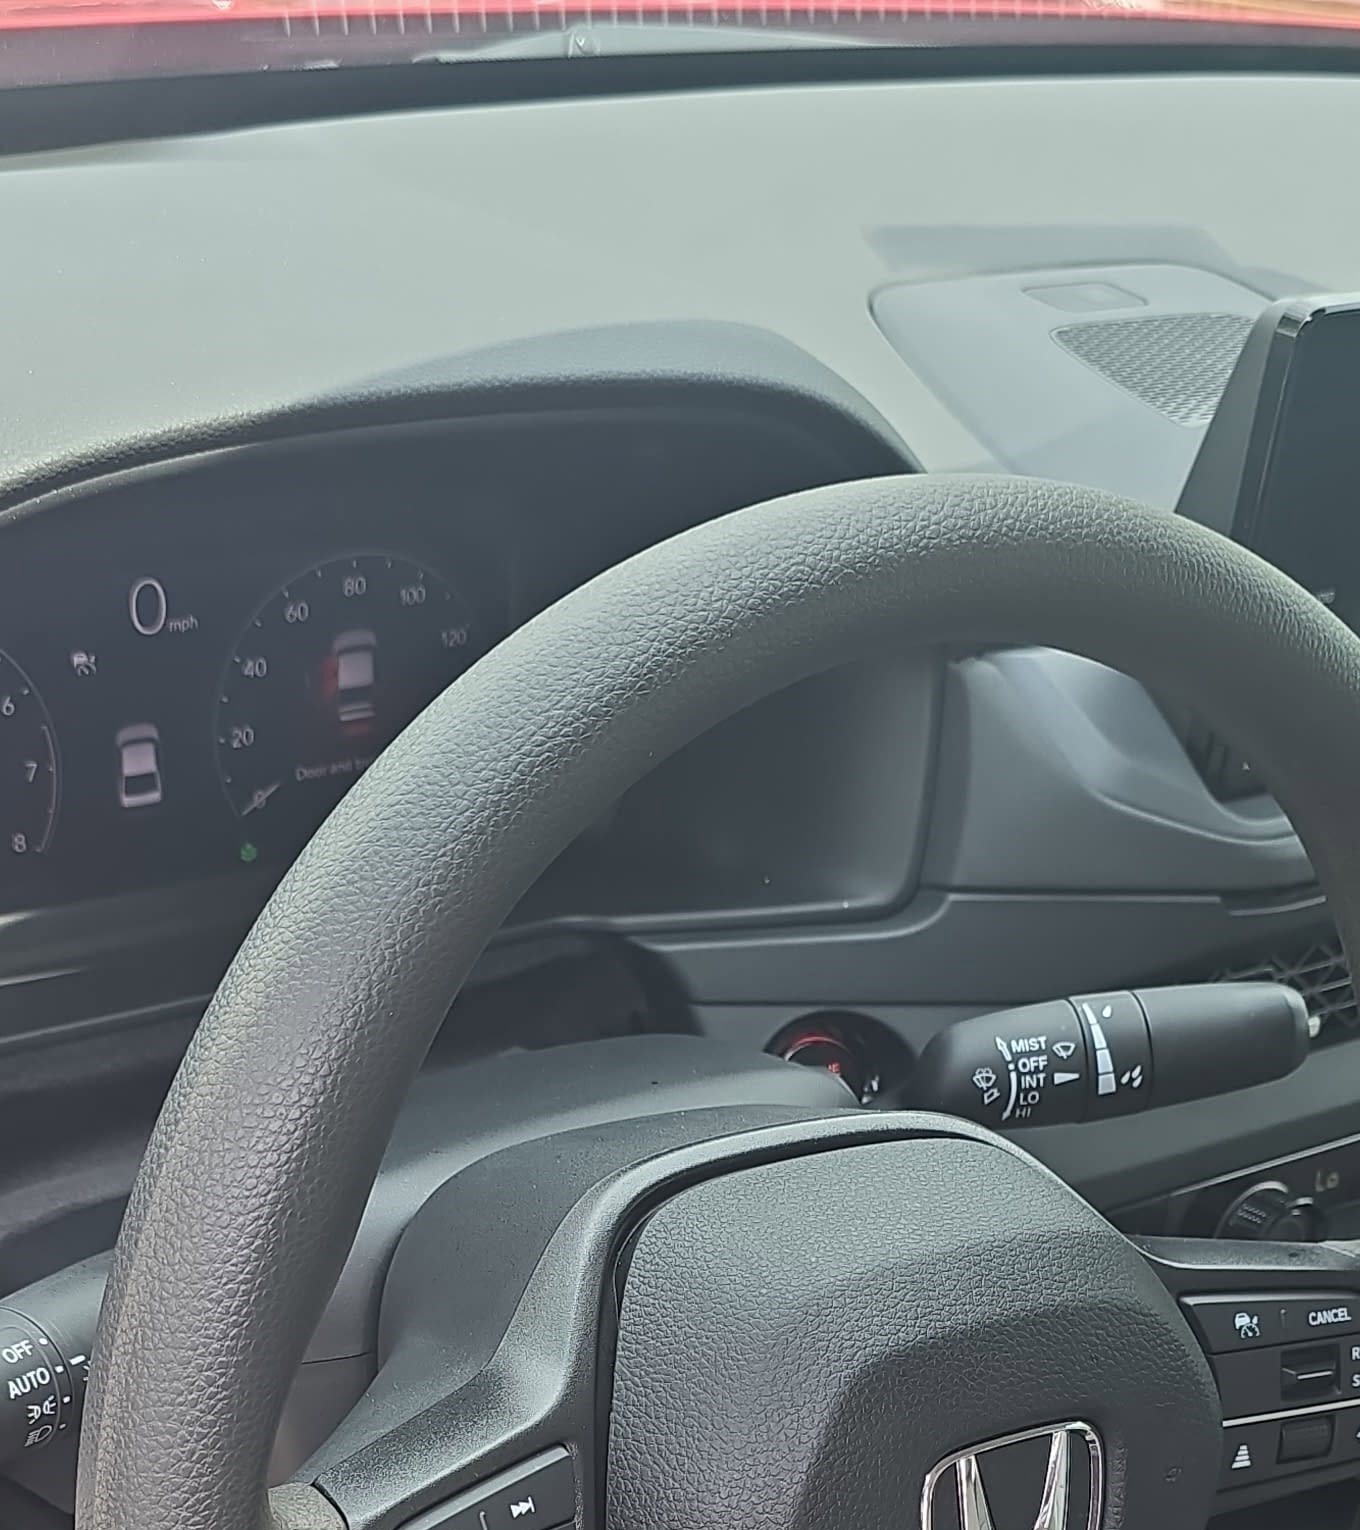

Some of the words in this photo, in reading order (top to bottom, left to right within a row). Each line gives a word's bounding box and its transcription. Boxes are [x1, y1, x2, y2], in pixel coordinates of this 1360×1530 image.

[343, 575, 367, 597] 80
[130, 576, 168, 637] 0
[168, 614, 199, 634] mph
[399, 587, 427, 606] 100
[285, 602, 310, 624] 60
[440, 628, 468, 648] 120
[243, 657, 268, 679] 40
[1, 697, 15, 717] 6
[231, 727, 255, 748] 20
[24, 761, 38, 783] 7
[11, 834, 27, 853] 8
[1011, 1034, 1048, 1054] MIST
[1018, 1055, 1049, 1073] OFF
[1020, 1072, 1046, 1089] INT
[1019, 1089, 1040, 1107] LO
[1015, 1107, 1032, 1120] HI
[1308, 1307, 1352, 1326] CANCEL
[1, 1340, 33, 1364] OFF
[7, 1367, 50, 1399] AUTO
